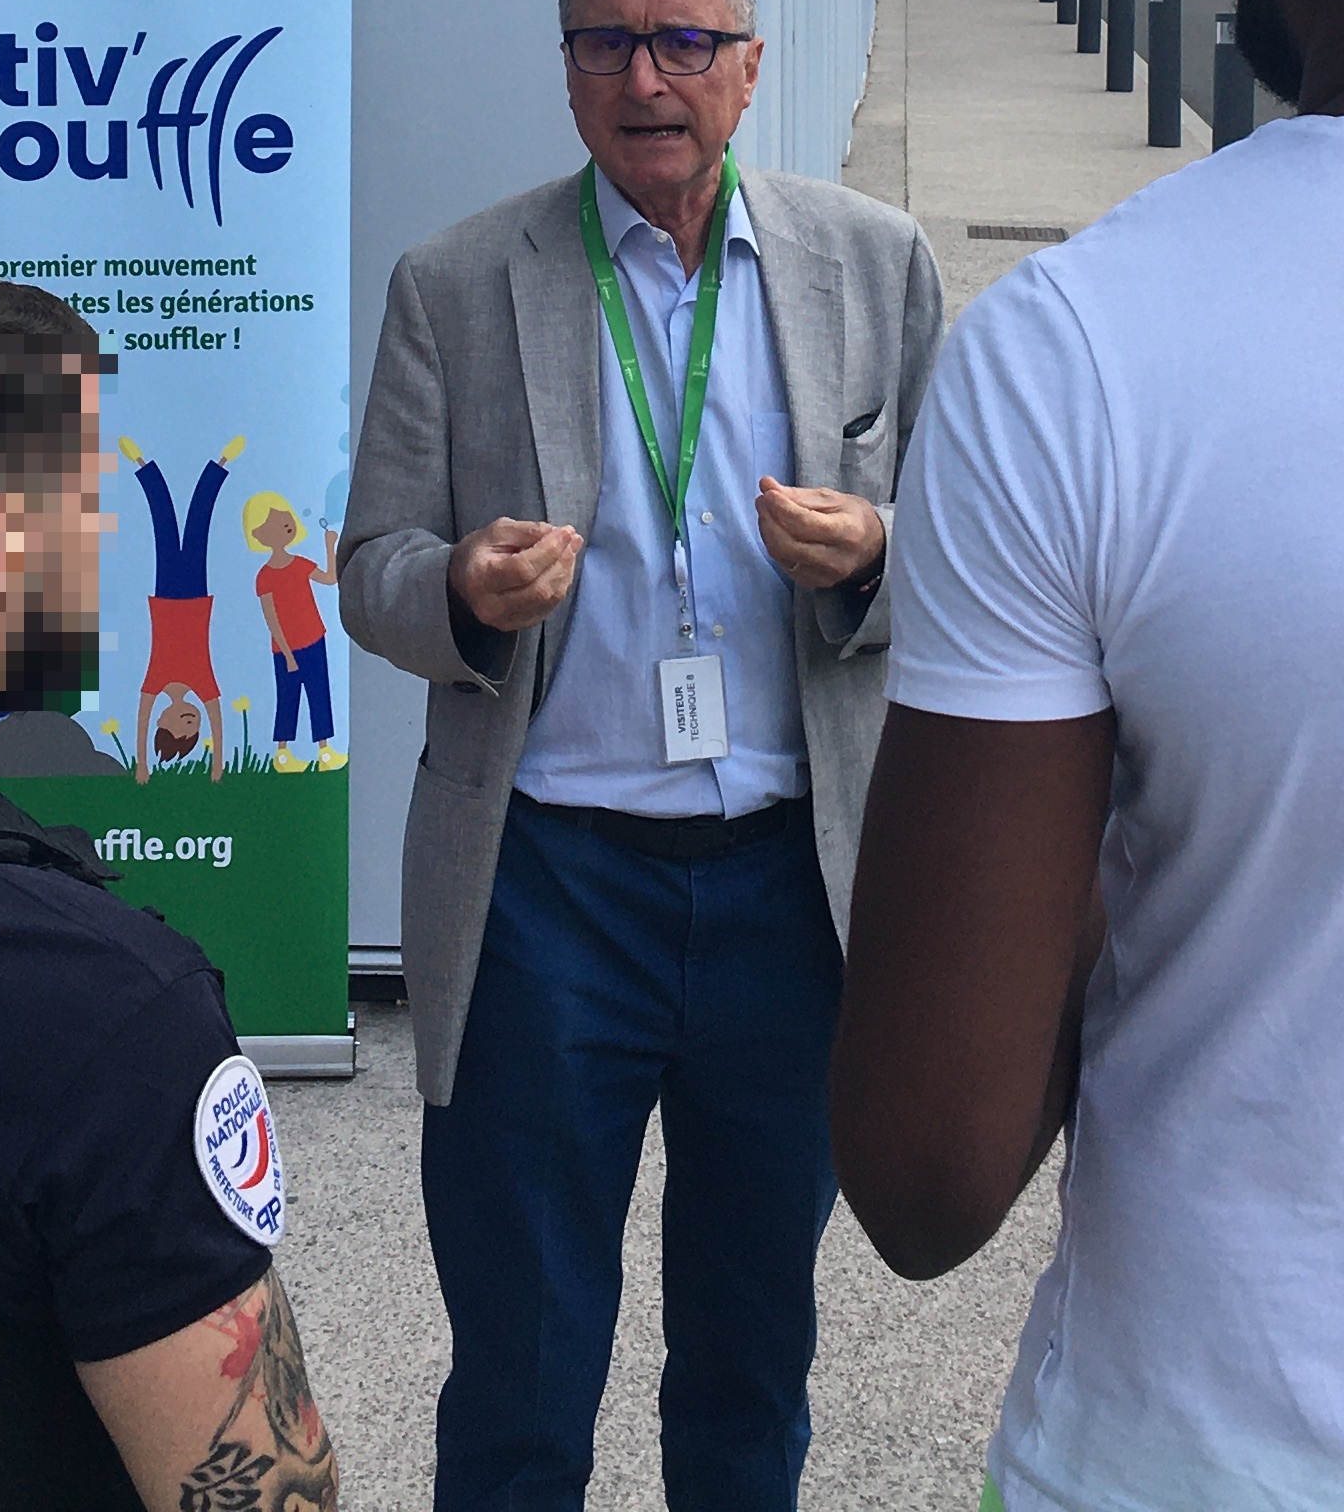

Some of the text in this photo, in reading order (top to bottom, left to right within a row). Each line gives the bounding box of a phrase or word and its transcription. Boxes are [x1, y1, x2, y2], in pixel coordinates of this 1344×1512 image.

[104, 254, 257, 277] mouvement
[117, 289, 154, 314] les
[160, 288, 314, 320] générations
[123, 326, 227, 351] souffler
[674, 686, 686, 733] VISITEUR
[686, 683, 699, 741] TECHNIQUE
[206, 1086, 263, 1154] NATIONALE
[212, 1077, 251, 1123] POLICE
[209, 1153, 254, 1222] PREFECTURE
